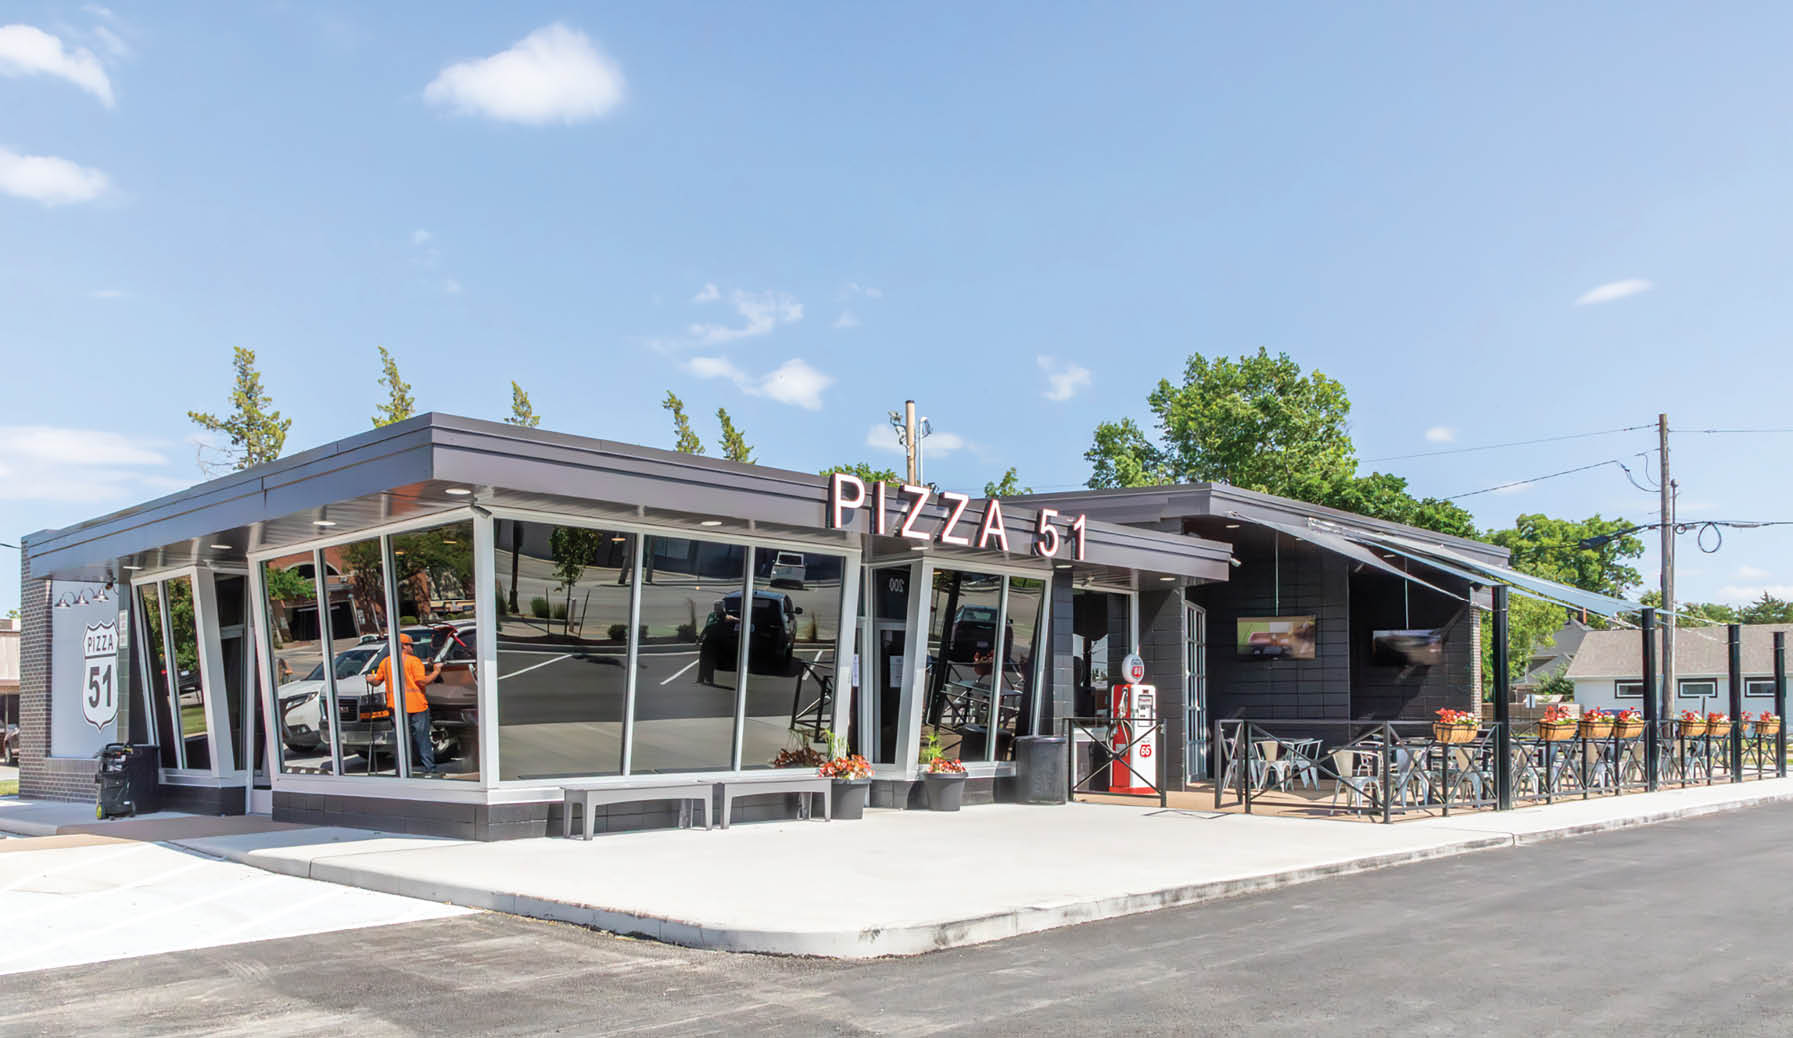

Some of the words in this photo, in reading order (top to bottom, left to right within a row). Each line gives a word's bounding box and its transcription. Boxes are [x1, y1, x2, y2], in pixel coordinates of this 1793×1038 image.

[832, 472, 1009, 550] PIZZA
[1038, 508, 1086, 560] 51
[87, 634, 113, 652] PIZZA
[88, 664, 111, 708] 51
[1140, 746, 1151, 756] 66
